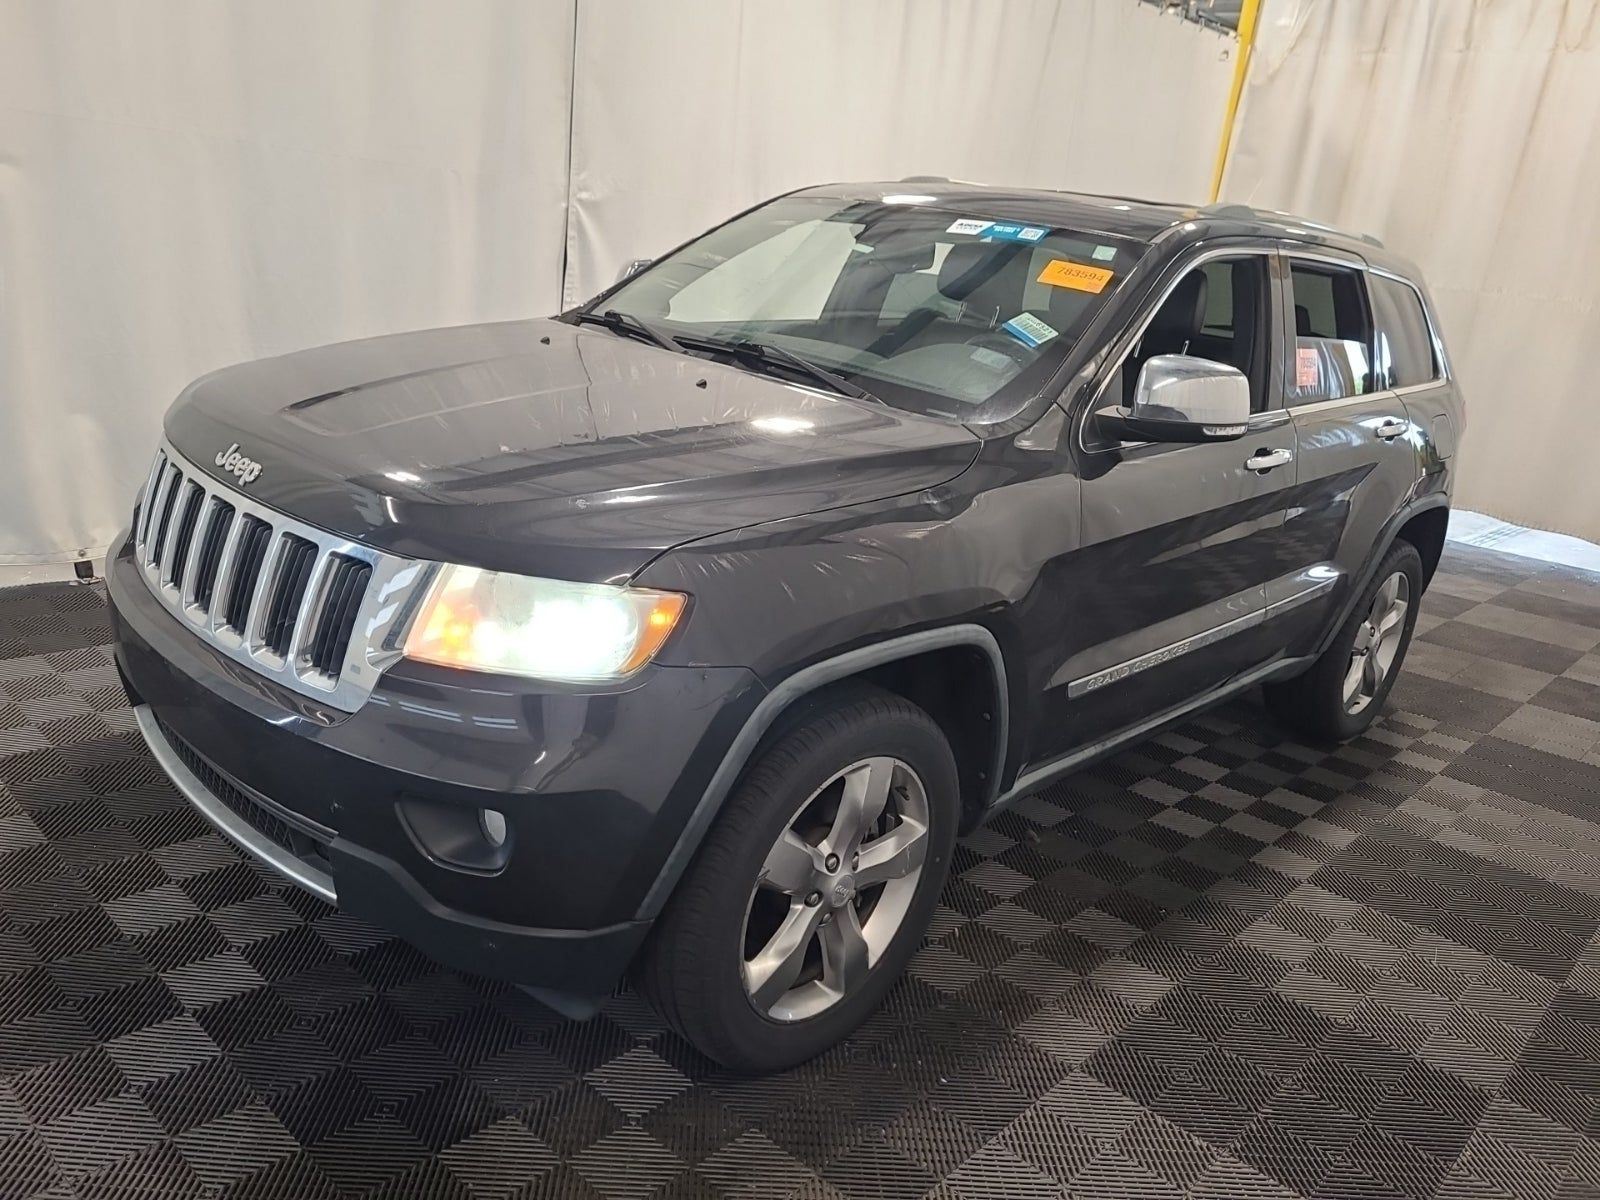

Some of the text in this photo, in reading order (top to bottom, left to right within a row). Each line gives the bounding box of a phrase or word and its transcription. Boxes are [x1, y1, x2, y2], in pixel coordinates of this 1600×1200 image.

[1057, 266, 1105, 282] 783594
[215, 443, 262, 486] Jeep
[1087, 642, 1192, 690] GRAND CHEROKEE
